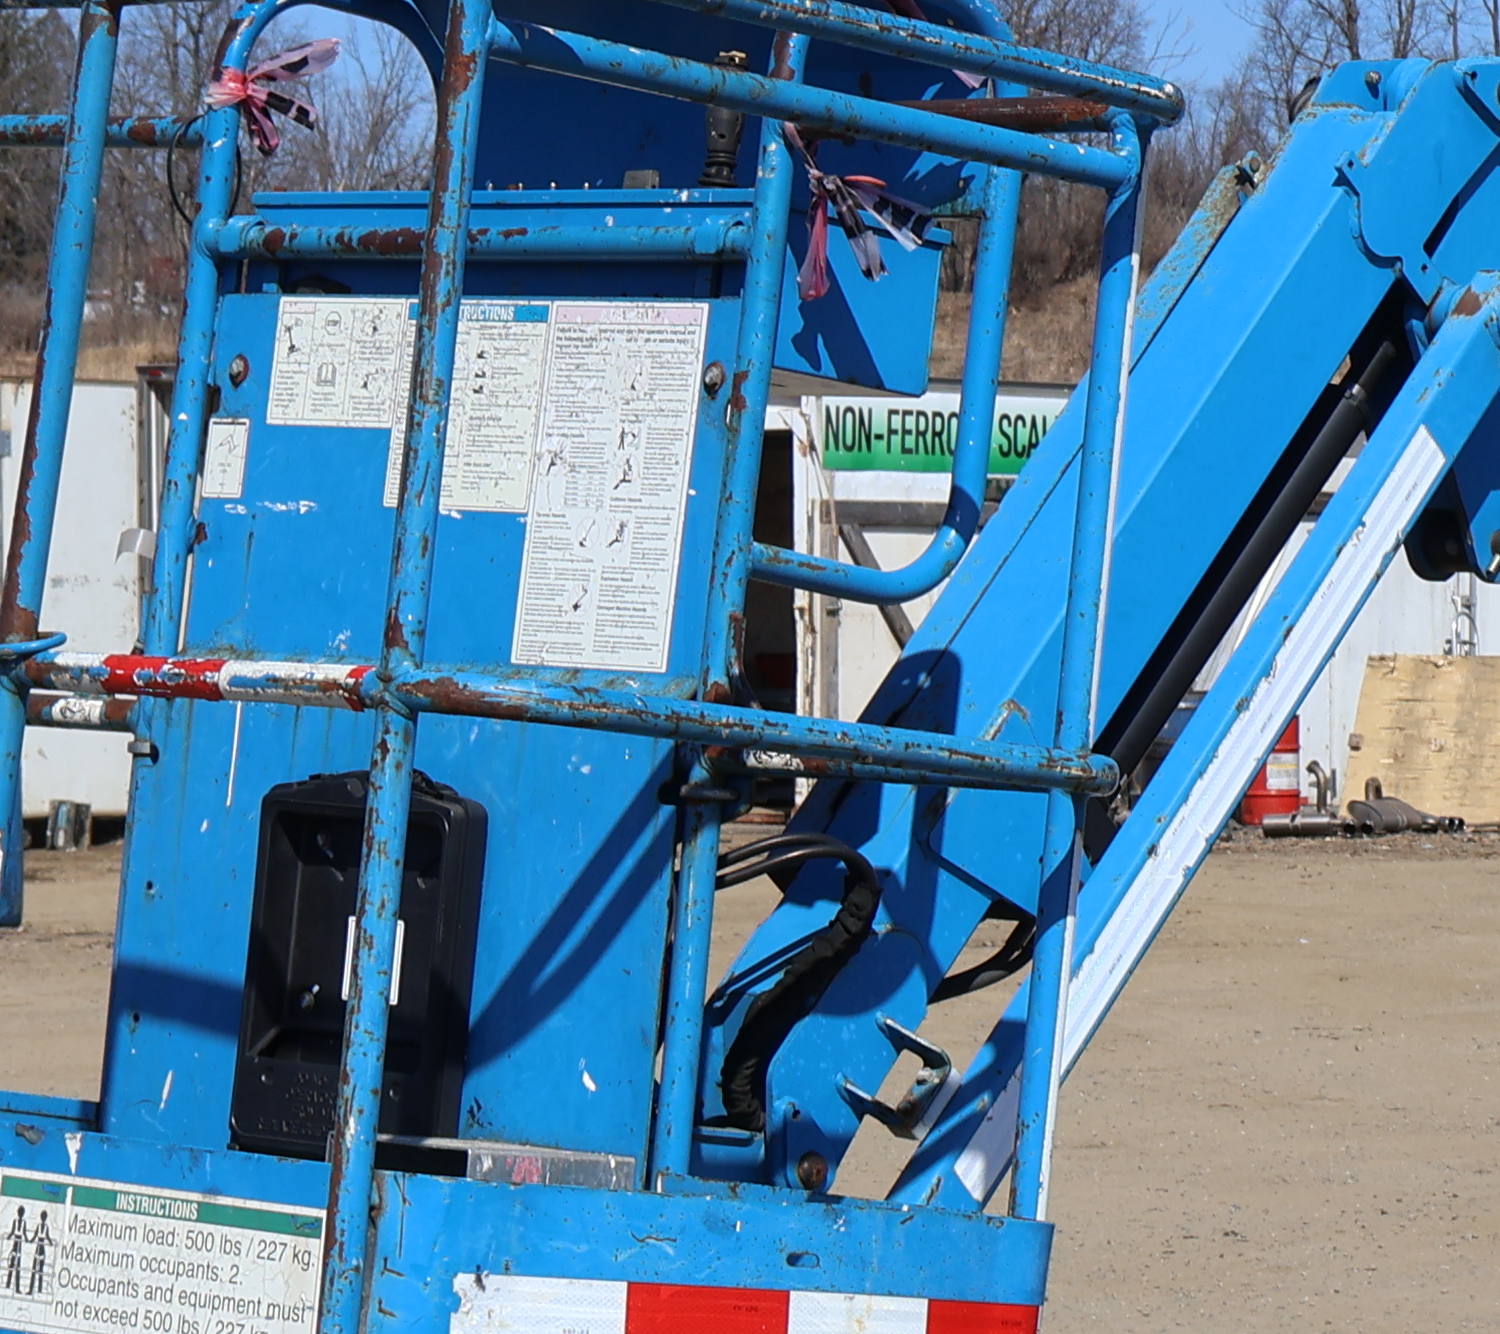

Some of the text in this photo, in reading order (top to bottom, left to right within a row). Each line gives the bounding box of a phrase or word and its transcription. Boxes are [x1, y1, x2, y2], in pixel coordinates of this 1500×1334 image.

[457, 302, 515, 322] TRUCTIONS
[824, 404, 1058, 459] NON-FERRO SCA
[115, 1192, 199, 1221] INSTRUCTIONS
[60, 1241, 243, 1286] Maximum occupants: 2.
[67, 1213, 315, 1272] Maximum load: 500 lbs / 227 kg.
[54, 1299, 79, 1319] not
[82, 1305, 139, 1329] exceed
[142, 1309, 173, 1333] 500
[57, 1267, 307, 1324] Occupants and equipment must
